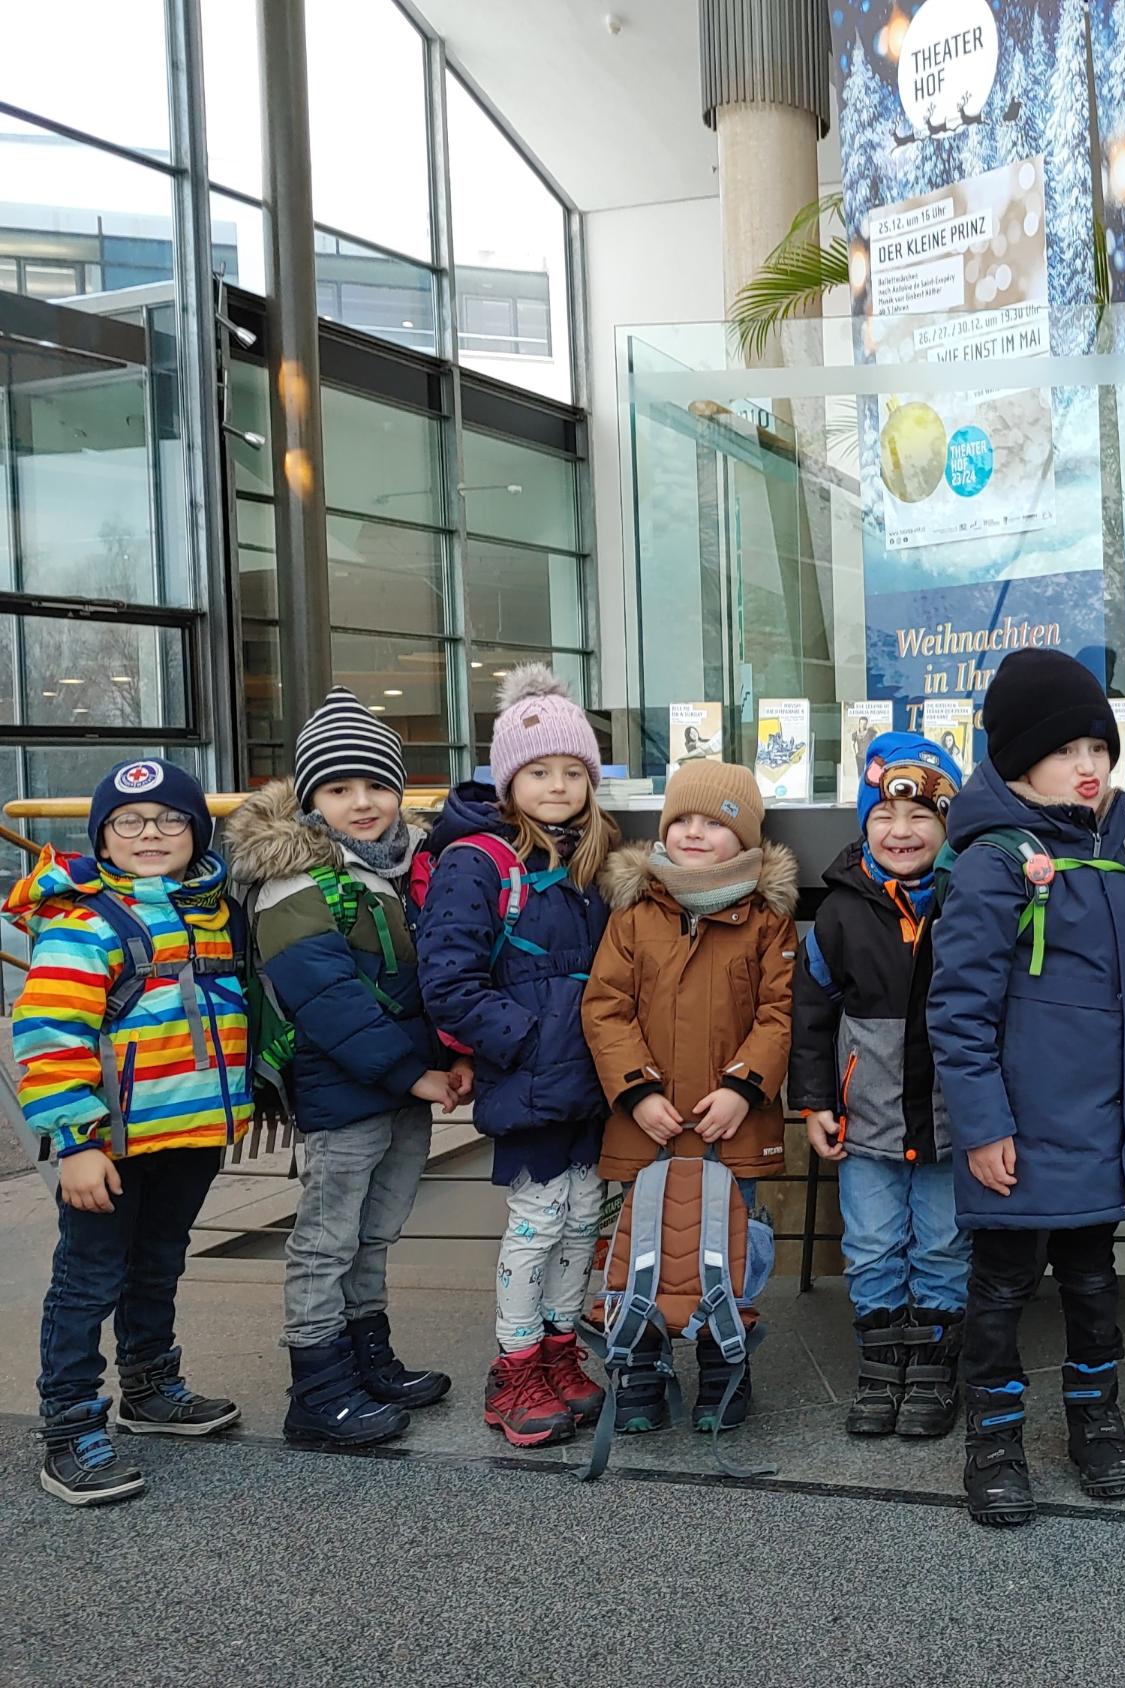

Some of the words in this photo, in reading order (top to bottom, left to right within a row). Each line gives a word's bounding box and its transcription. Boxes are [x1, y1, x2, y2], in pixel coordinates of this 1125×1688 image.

[911, 26, 984, 74] THEATER
[914, 67, 945, 103] HOF
[878, 217, 904, 235] 25.12.
[906, 216, 919, 228] um
[921, 211, 931, 225] 16
[932, 205, 947, 220] Uhr
[878, 242, 903, 264] DER
[906, 228, 947, 252] KLEINE
[950, 216, 986, 245] PRINZ
[985, 313, 998, 325] um
[1025, 304, 1041, 318] Uhr
[962, 338, 998, 362] EINST
[1001, 333, 1015, 354] IM
[1020, 327, 1041, 349] MAI
[951, 439, 987, 459] THEATER
[951, 457, 969, 472] HOF
[952, 470, 976, 486] 23/24
[896, 616, 1061, 658] Weihnachten
[924, 664, 948, 694] in
[955, 659, 995, 692] Ihr
